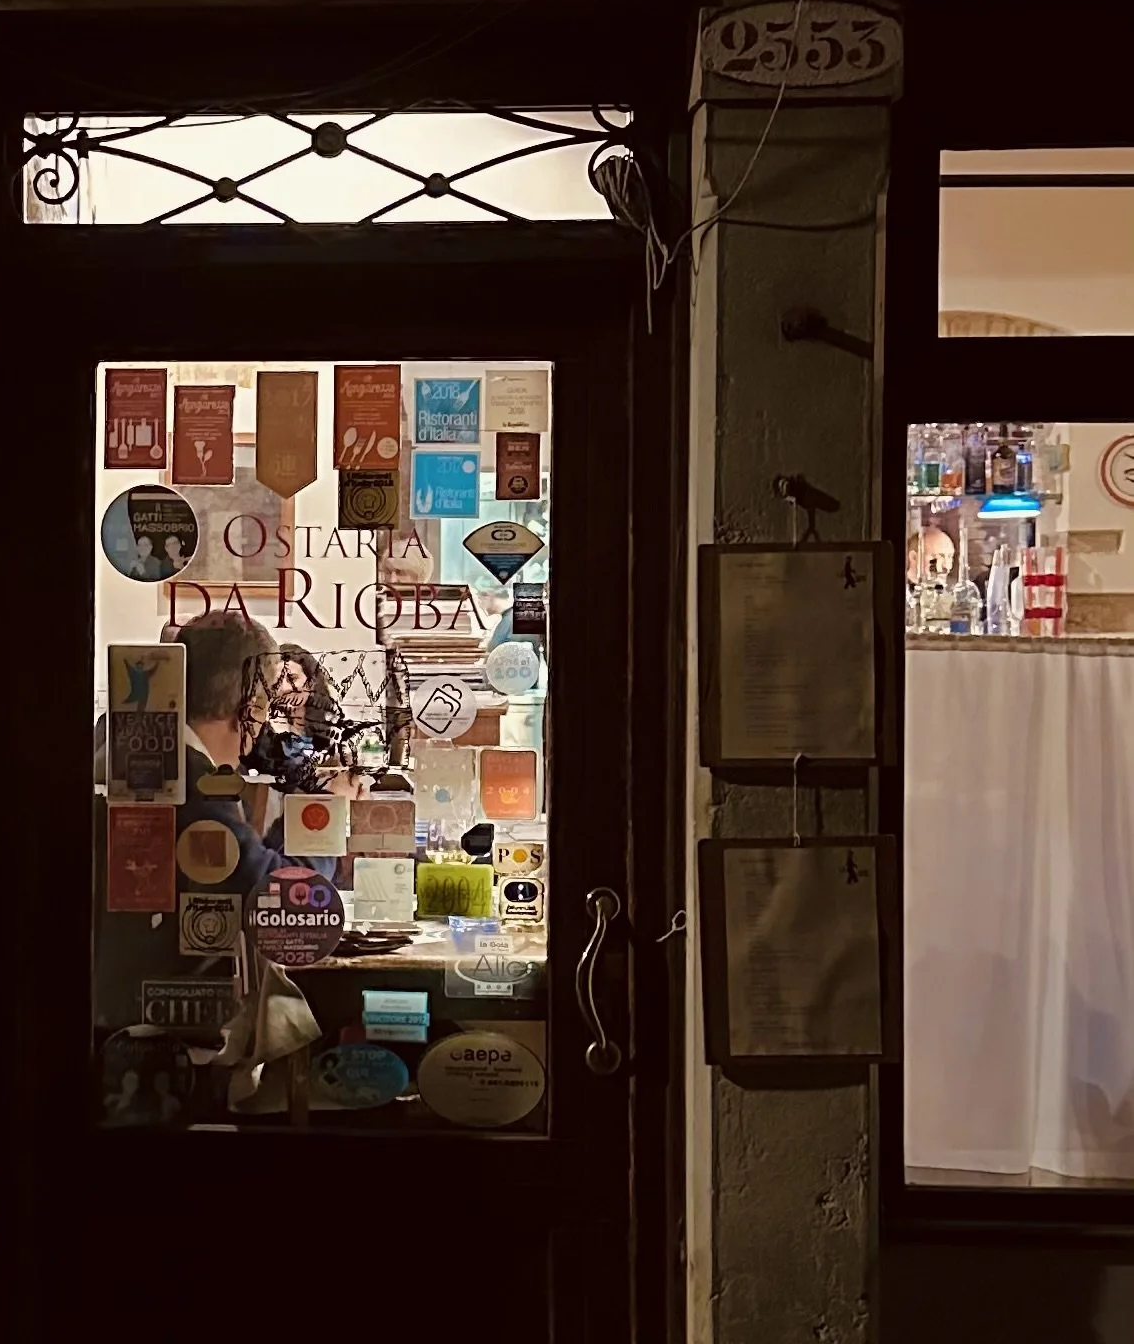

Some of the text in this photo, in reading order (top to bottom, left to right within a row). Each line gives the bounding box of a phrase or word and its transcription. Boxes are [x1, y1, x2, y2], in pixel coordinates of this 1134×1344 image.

[720, 19, 887, 72] 2553
[432, 382, 461, 400] 2018
[418, 410, 477, 426] Ristoranti
[418, 427, 456, 441] d'Italia
[435, 487, 474, 497] Ristoranti
[435, 498, 463, 509] d'Italia
[133, 512, 163, 522] GATTI
[133, 523, 195, 533] MASSOBRIO
[223, 514, 433, 560] OSTARIA
[167, 567, 488, 630] DA RIOBA
[116, 736, 175, 752] FOOD
[276, 952, 316, 964] 2025
[146, 987, 215, 997] CONSIGLIATO
